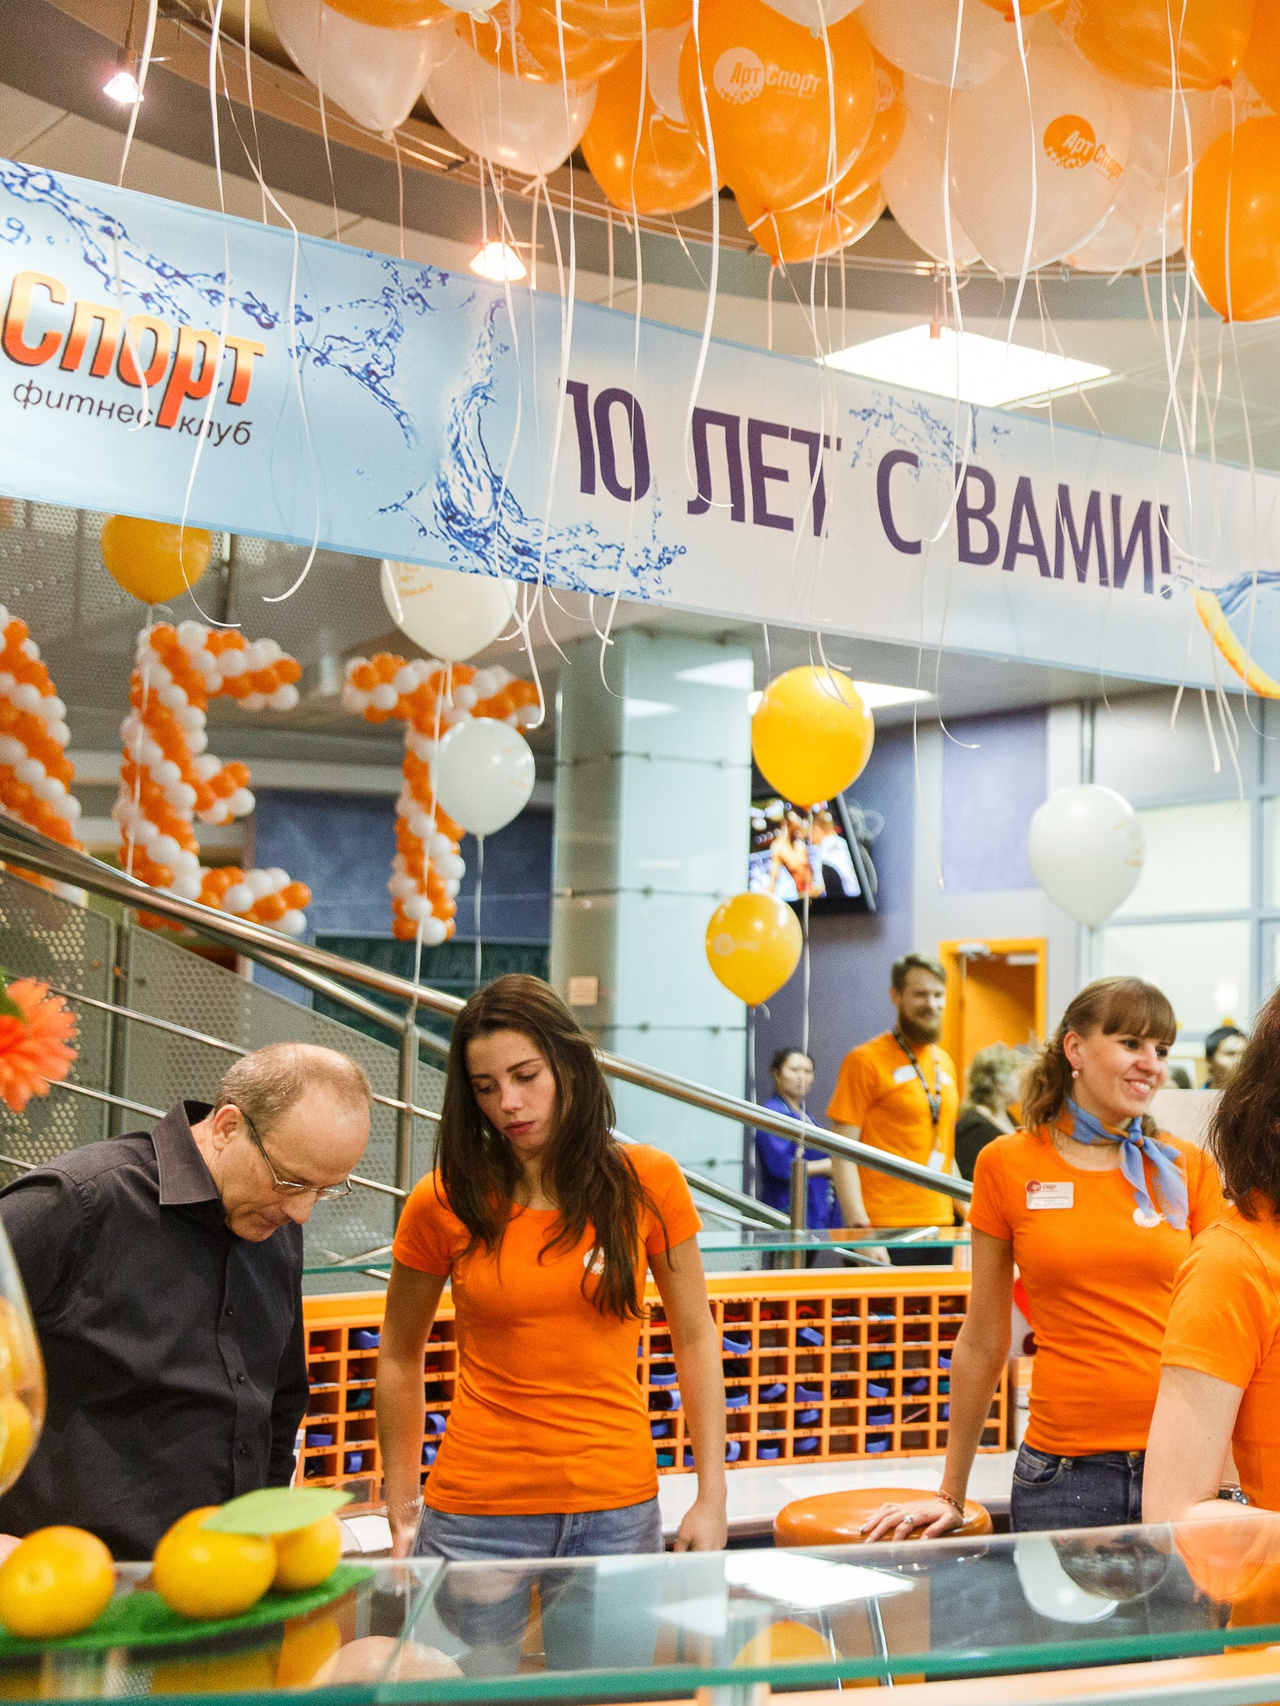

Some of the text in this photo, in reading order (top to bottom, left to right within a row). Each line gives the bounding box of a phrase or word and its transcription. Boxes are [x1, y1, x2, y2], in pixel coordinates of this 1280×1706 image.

[729, 61, 822, 98] Арт Спорт
[1061, 130, 1095, 156] Арт
[1, 270, 267, 430] Спорт
[12, 379, 254, 447] фитнес клуб
[558, 379, 1174, 601] 10 ЛЕТ С ВАМИ!
